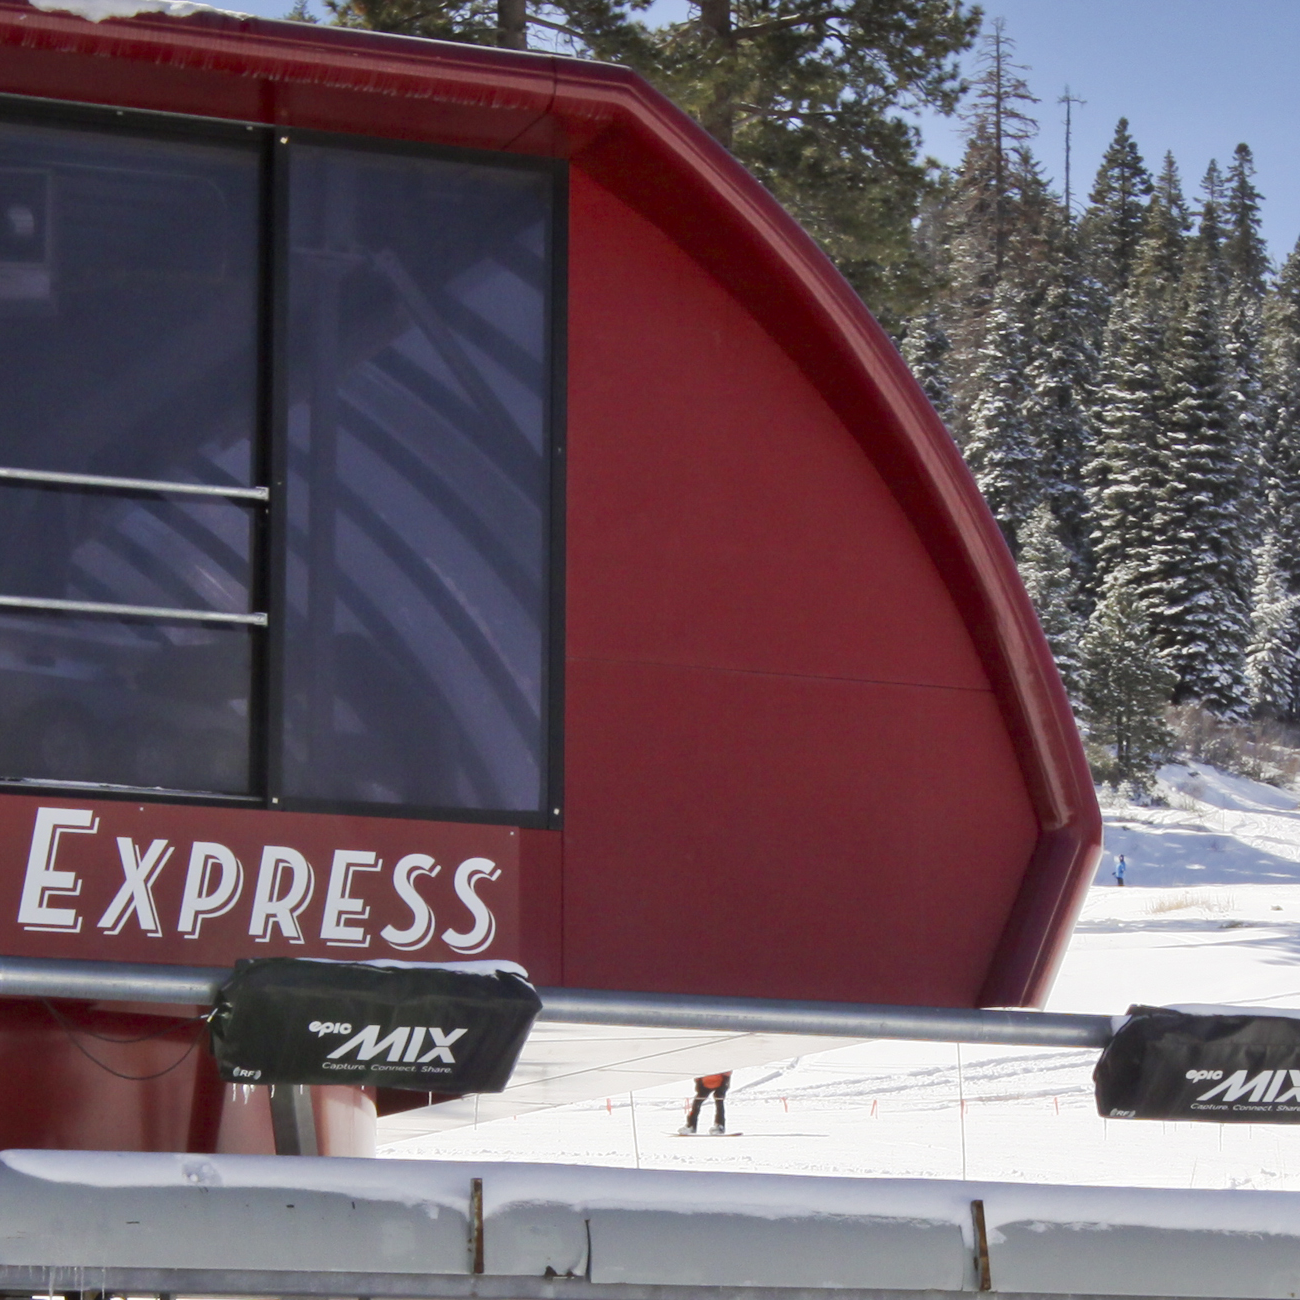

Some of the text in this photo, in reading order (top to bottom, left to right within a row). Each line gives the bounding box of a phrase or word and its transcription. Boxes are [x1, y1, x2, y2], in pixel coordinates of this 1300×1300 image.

[17, 806, 501, 955] EXPRESS
[308, 1020, 468, 1064] epic MIX
[1185, 1069, 1223, 1084] epic
